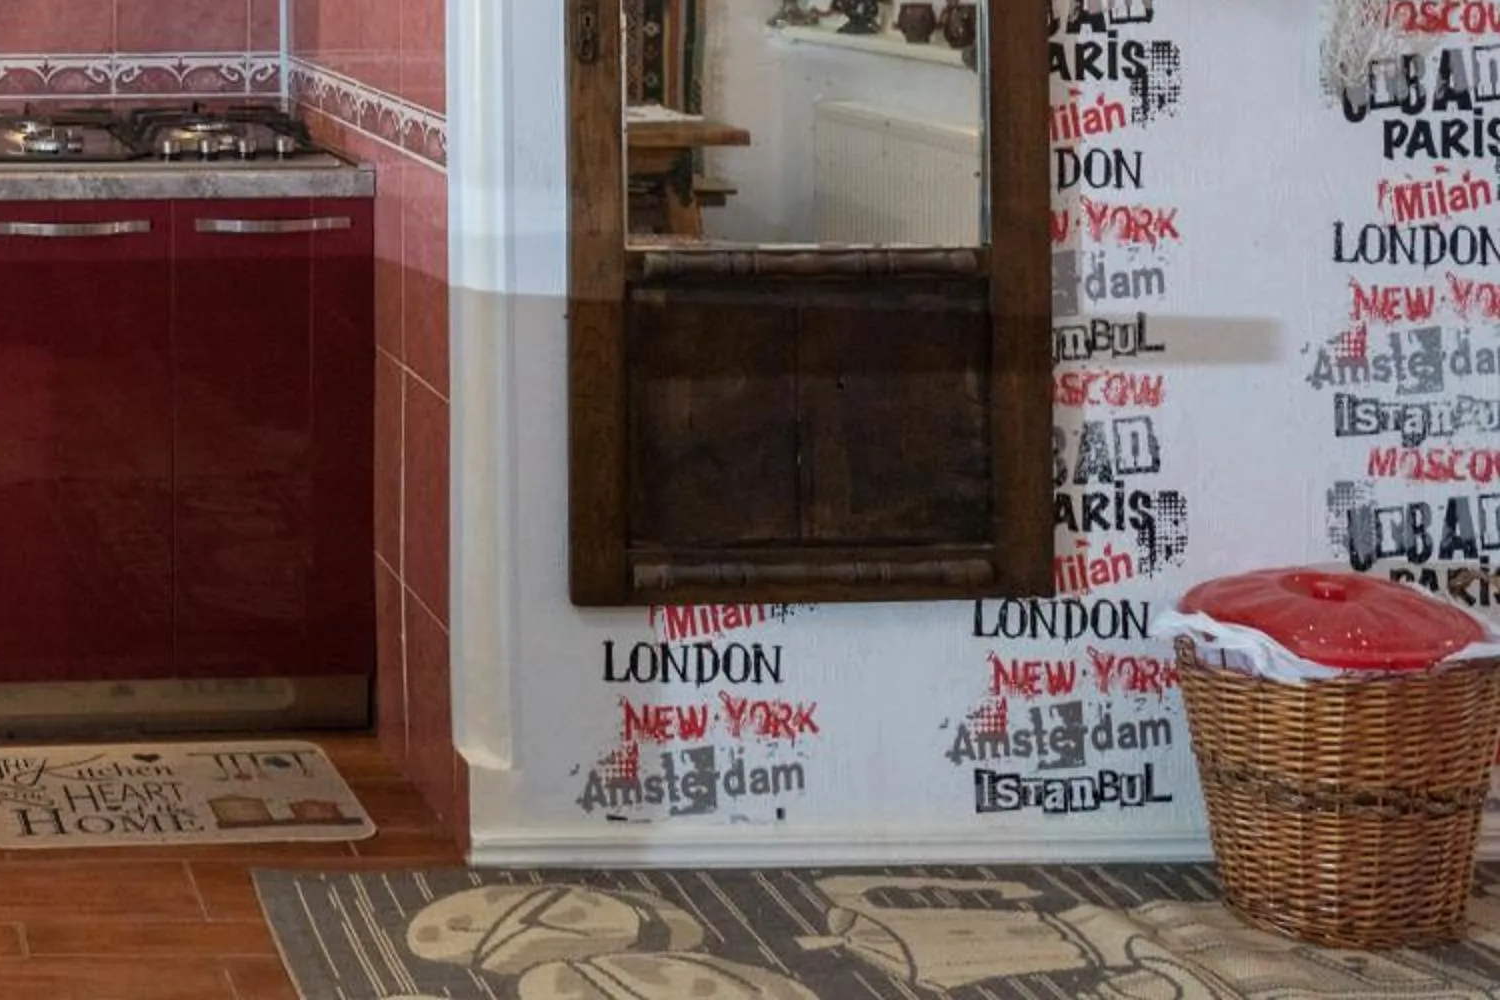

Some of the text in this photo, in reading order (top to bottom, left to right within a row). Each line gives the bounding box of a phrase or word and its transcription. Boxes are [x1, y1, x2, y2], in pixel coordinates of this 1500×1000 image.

[973, 598, 1151, 646] LONDON
[602, 638, 785, 688] LONDON
[987, 650, 1077, 701] NEW
[620, 690, 820, 747] NEW YORK
[945, 701, 1174, 770] Amsterdam
[62, 782, 185, 813] HEART
[576, 746, 805, 817] Amsterdam
